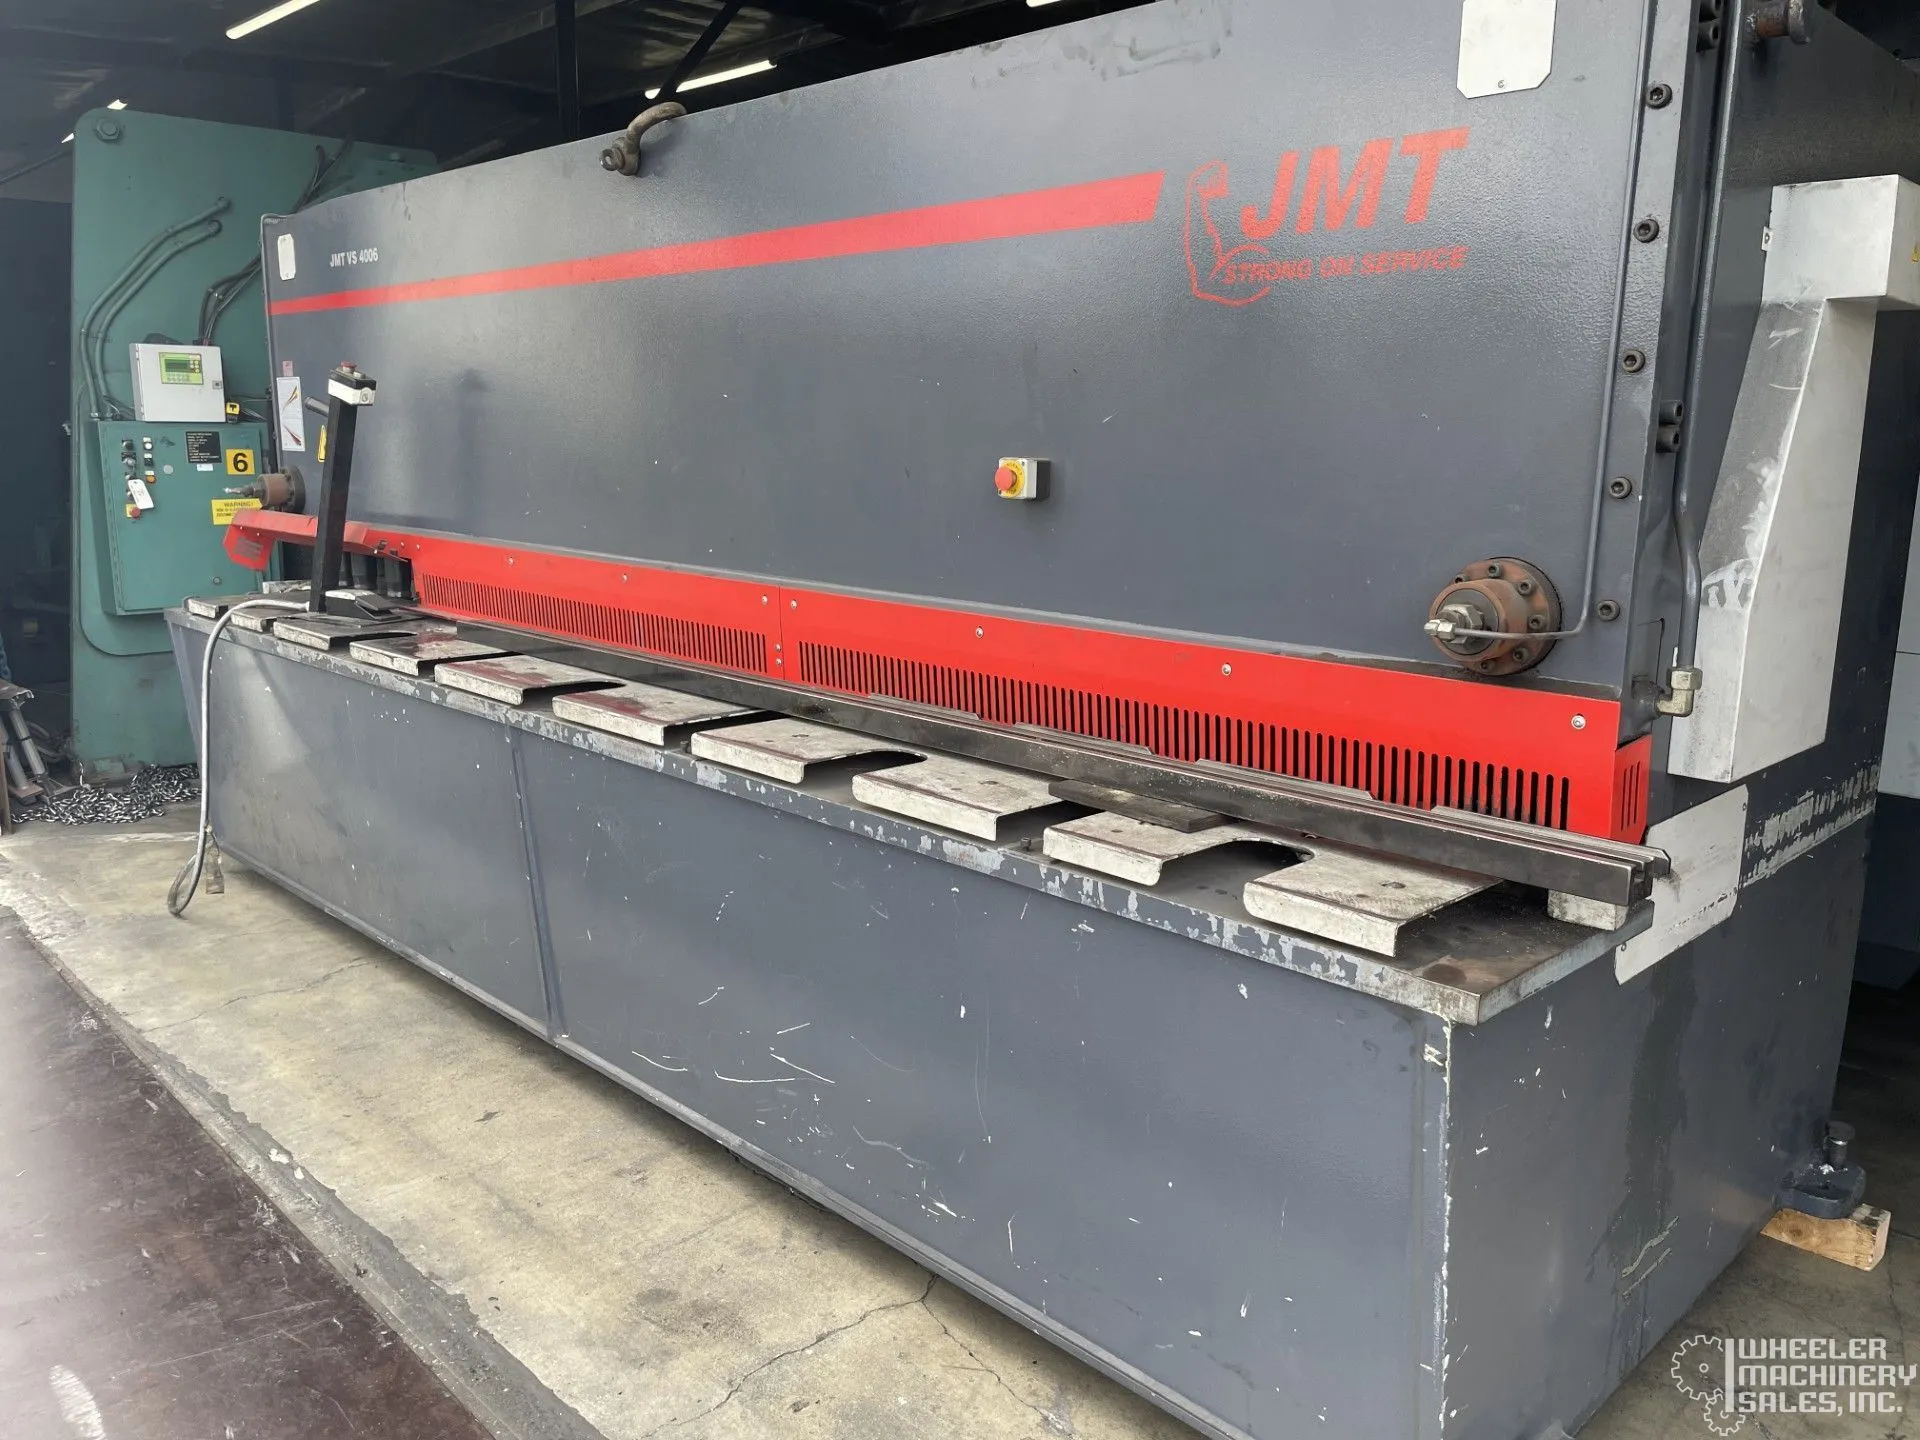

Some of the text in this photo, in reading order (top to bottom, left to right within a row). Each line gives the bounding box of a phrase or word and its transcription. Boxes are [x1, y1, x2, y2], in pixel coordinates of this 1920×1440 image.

[1239, 126, 1470, 240] JMT
[329, 247, 379, 268] JMT VS 4006
[1221, 245, 1470, 285] STRONG ON SERVICE
[233, 452, 248, 472] 6
